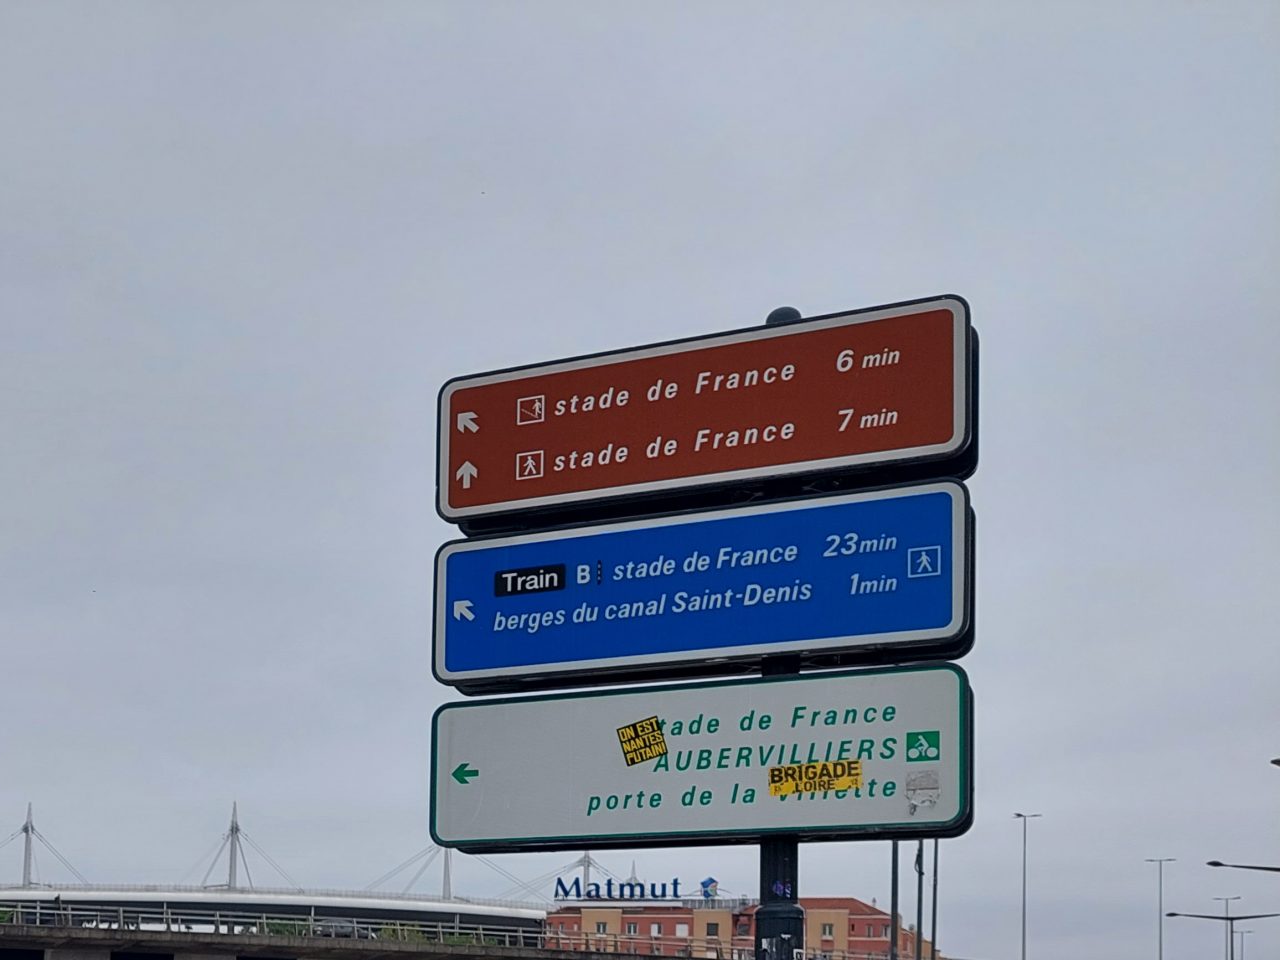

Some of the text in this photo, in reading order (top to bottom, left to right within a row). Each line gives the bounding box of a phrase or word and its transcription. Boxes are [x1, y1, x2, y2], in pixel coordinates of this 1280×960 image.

[553, 348, 900, 417] stade de France 6 min
[553, 408, 898, 473] stade de France 7 min
[502, 569, 558, 594] Train
[576, 565, 591, 585] B
[612, 553, 676, 582] stade
[683, 549, 711, 574] de
[716, 542, 798, 570] France
[493, 602, 566, 634] berges
[572, 600, 599, 625] du
[603, 592, 666, 620] canal
[671, 580, 812, 615] Saint-Denis
[618, 718, 658, 741] ON EST
[658, 701, 897, 738] tade de France
[623, 730, 663, 752] NANTES
[653, 738, 898, 773] AUBERVILLIERS
[770, 760, 861, 784] BRIGADE
[794, 779, 836, 793] LOIRE
[587, 789, 663, 816] porte
[681, 782, 713, 807] de
[731, 781, 756, 805] la
[554, 876, 681, 899] Matmut
